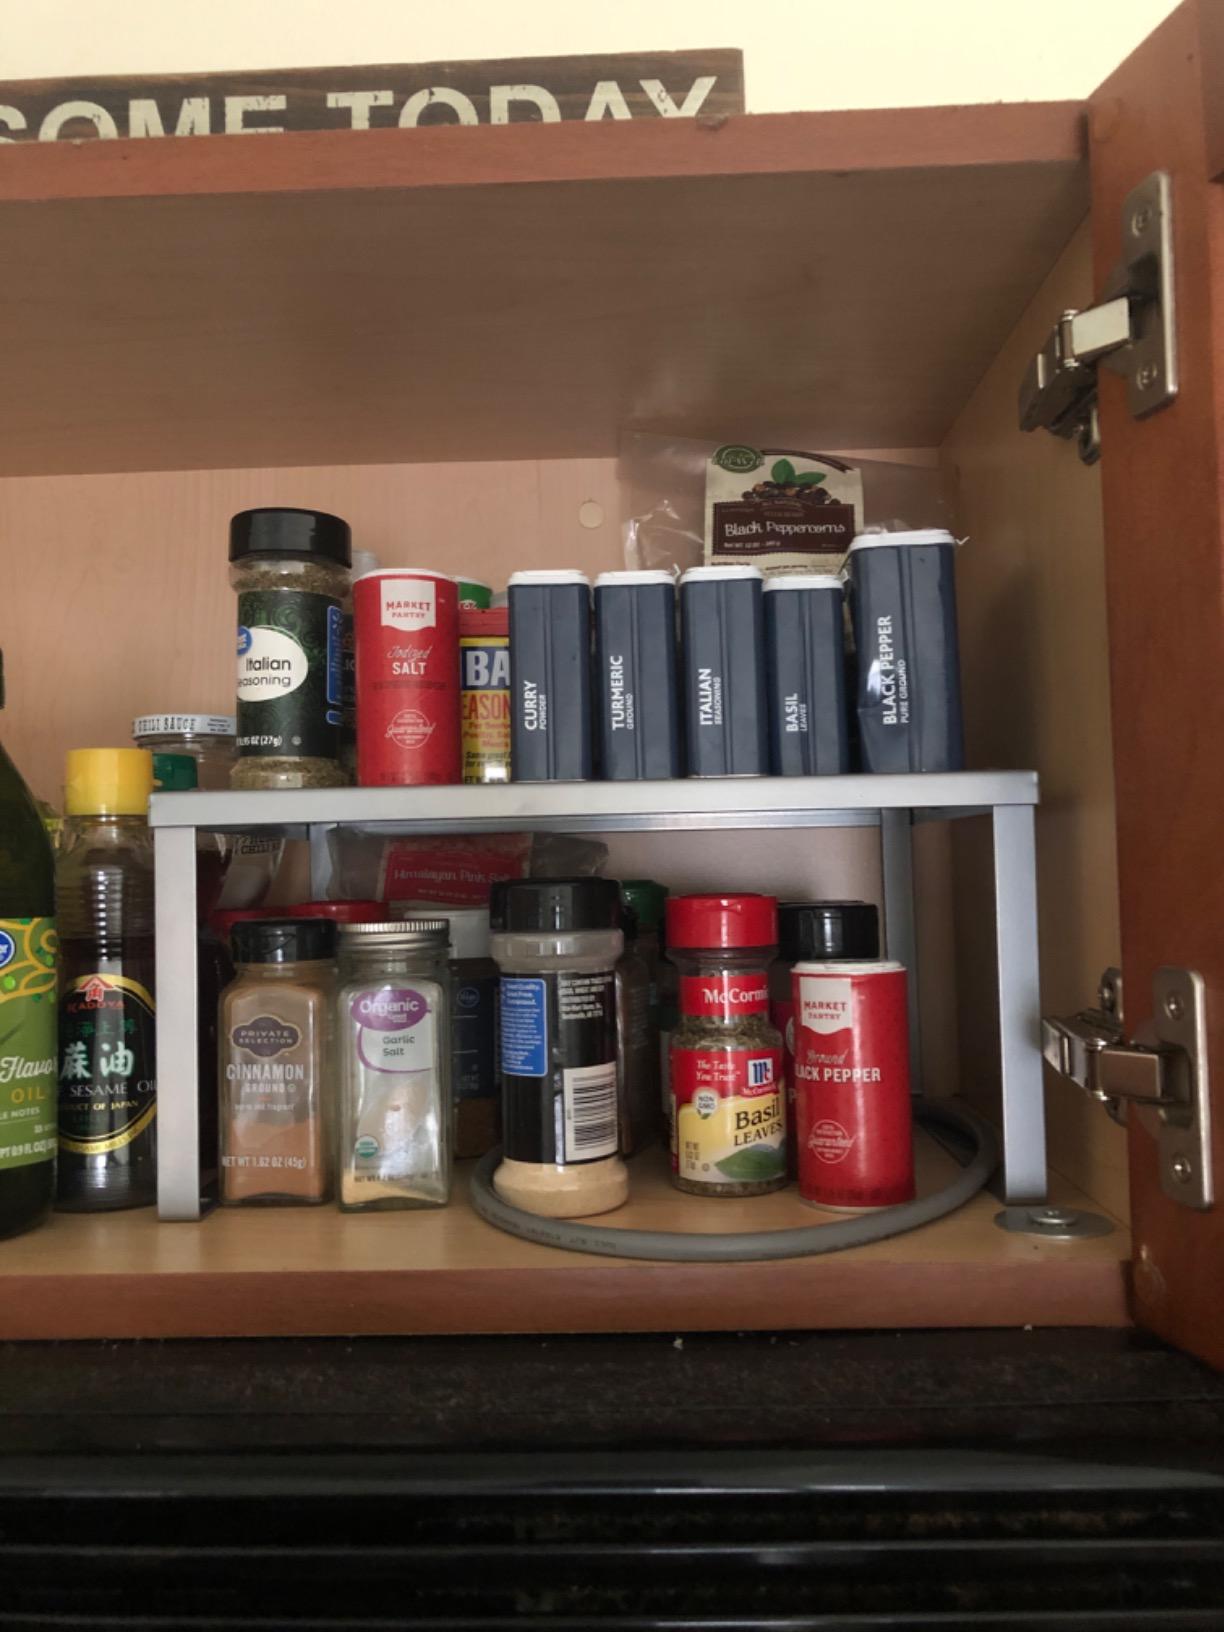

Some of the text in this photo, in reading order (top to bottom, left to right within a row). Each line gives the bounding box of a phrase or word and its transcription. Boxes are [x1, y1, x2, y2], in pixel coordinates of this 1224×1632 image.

[724, 521, 845, 537] Black Peppercorns
[386, 601, 431, 611] MARKET
[246, 657, 290, 671] Italian
[392, 662, 427, 675] SALT
[878, 615, 897, 725] BLACK PEPPER
[610, 655, 624, 730] TURMERIC
[699, 668, 713, 725] ITALIAN
[524, 680, 537, 730] CURRY
[713, 677, 722, 725] SEASONING
[539, 694, 547, 730] POWDER
[626, 693, 634, 730] GROUND
[785, 693, 799, 732] BASIL
[900, 702, 909, 724] PURE
[163, 716, 196, 731] SAUCE
[261, 734, 282, 748] (27g)
[360, 996, 419, 1016] Organic
[804, 1001, 847, 1012] MARKET
[383, 1034, 415, 1044] Garlic
[383, 1048, 404, 1057] Salt
[226, 1063, 304, 1080] CINNAMON
[823, 1066, 881, 1082] PEPPER
[11, 1086, 46, 1105] OIL
[70, 1081, 128, 1097] SESAME
[245, 1082, 285, 1093] GROUND
[11, 1106, 40, 1118] NOTES
[92, 1102, 106, 1111] OF
[111, 1100, 138, 1110] JAPAN
[735, 1096, 779, 1130] Basil
